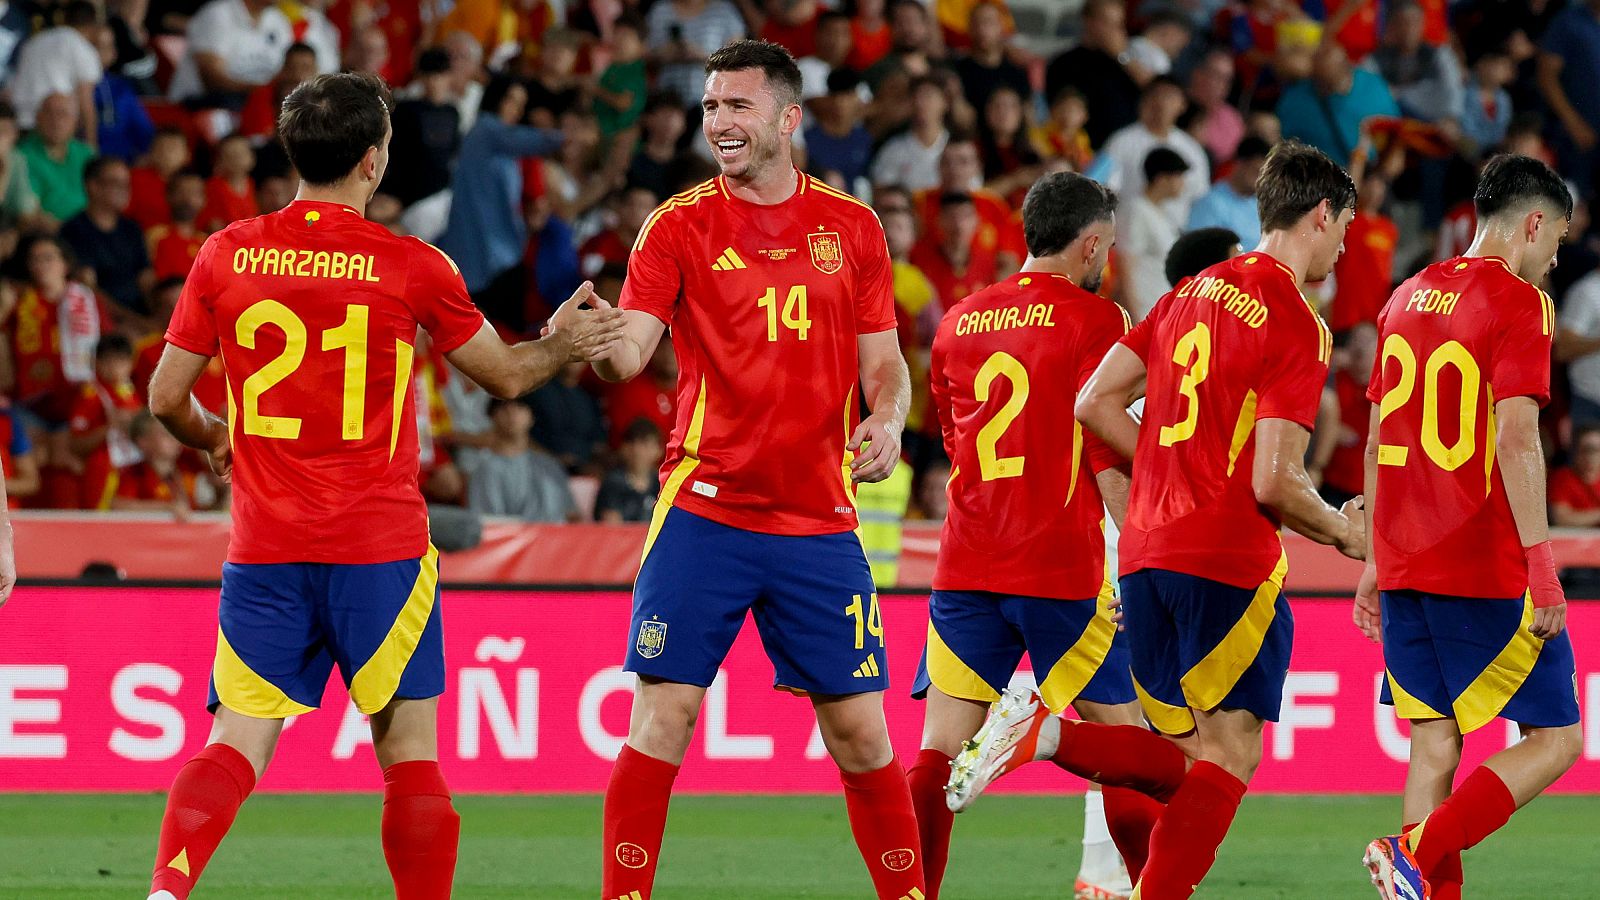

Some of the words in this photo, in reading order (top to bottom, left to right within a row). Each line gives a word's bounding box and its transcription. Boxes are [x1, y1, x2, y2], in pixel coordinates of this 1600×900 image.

[233, 247, 380, 282] OYARZABAL
[757, 285, 812, 342] 14
[955, 303, 1056, 337] CARVAJAL
[1405, 288, 1461, 315] PEDRI
[235, 299, 369, 440] 21
[1158, 321, 1211, 447] 3
[974, 351, 1030, 481] 2
[1378, 333, 1480, 471] 20
[845, 592, 884, 649] 14
